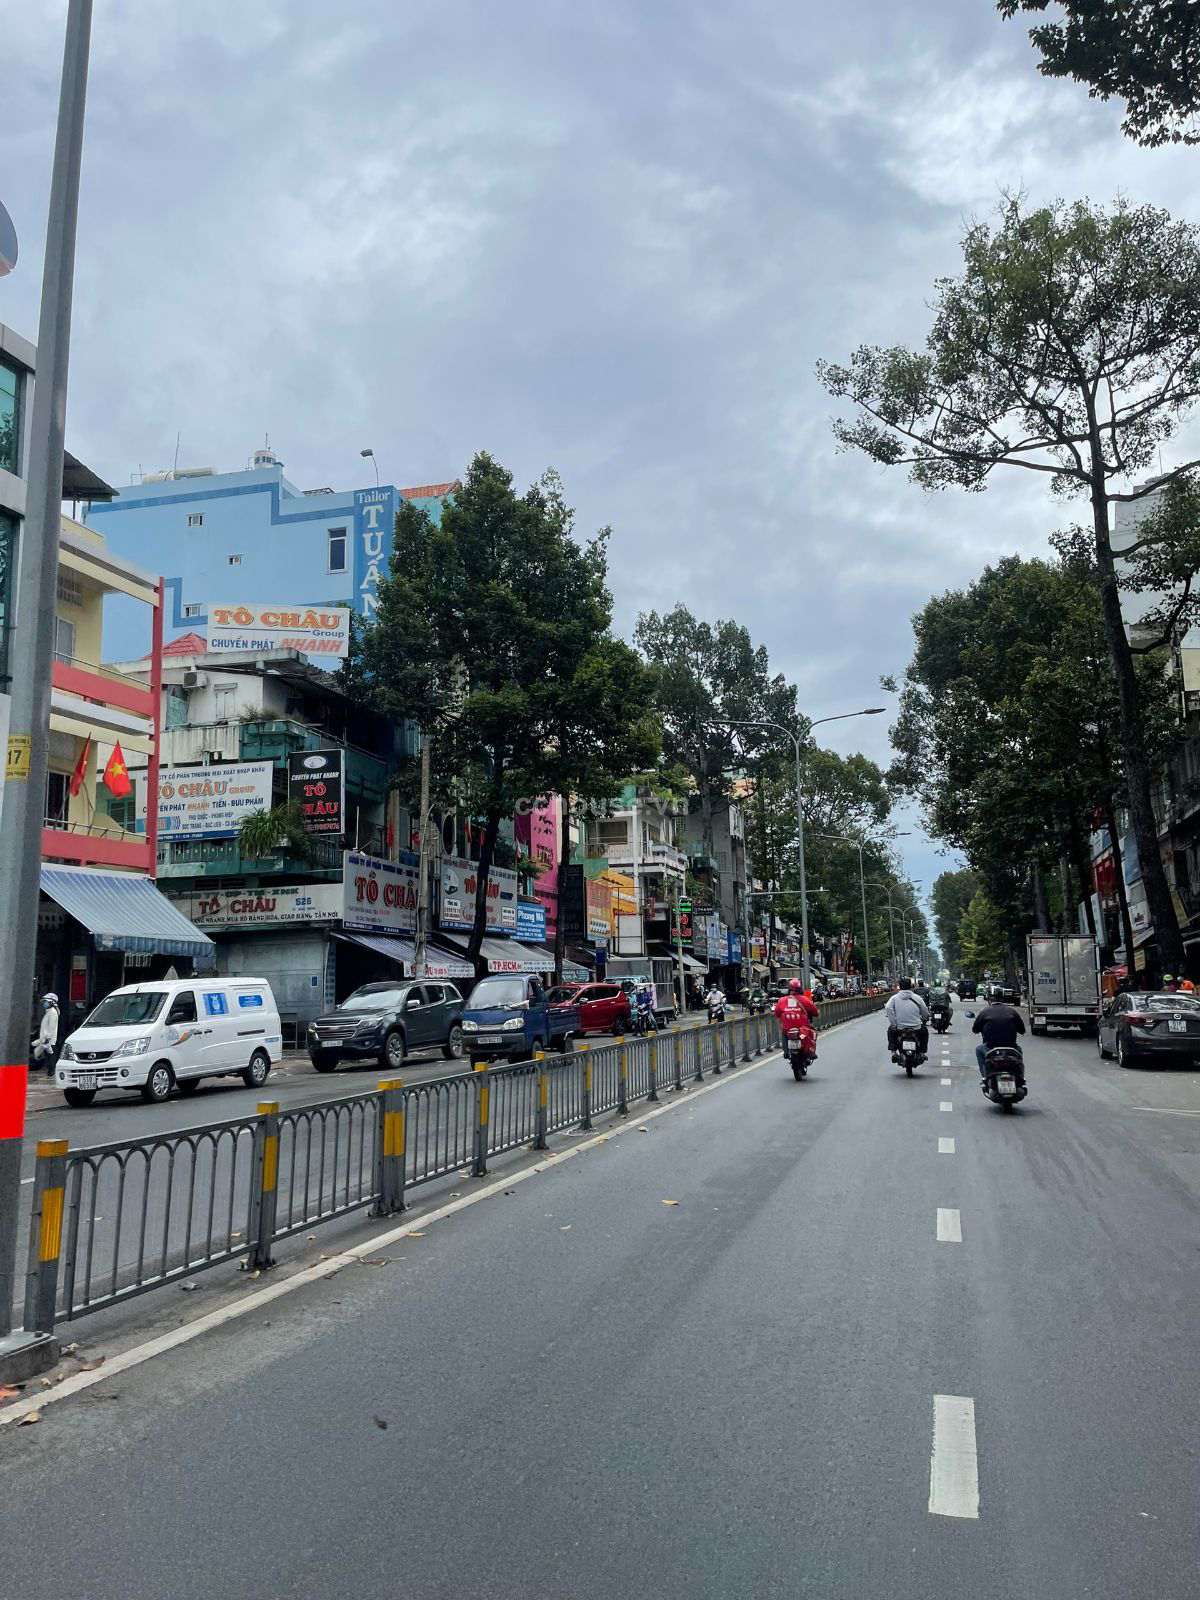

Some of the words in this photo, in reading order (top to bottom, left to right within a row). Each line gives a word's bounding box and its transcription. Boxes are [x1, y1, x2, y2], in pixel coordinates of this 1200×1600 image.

[357, 491, 391, 504] Tailor
[213, 606, 255, 627] TÔ
[260, 609, 341, 630] CHÂU
[312, 629, 346, 639] Group
[281, 638, 345, 653] NHANH
[158, 782, 175, 800] Ô
[178, 778, 229, 798] CHÂU
[229, 785, 257, 795] GROUP
[303, 781, 327, 797] TÔ
[354, 870, 379, 904] TÔ
[384, 879, 418, 910] CHÂ
[230, 895, 277, 914] CHÂU
[296, 897, 312, 906] 526
[517, 908, 536, 923] Phong
[492, 960, 517, 971] TP.HCM
